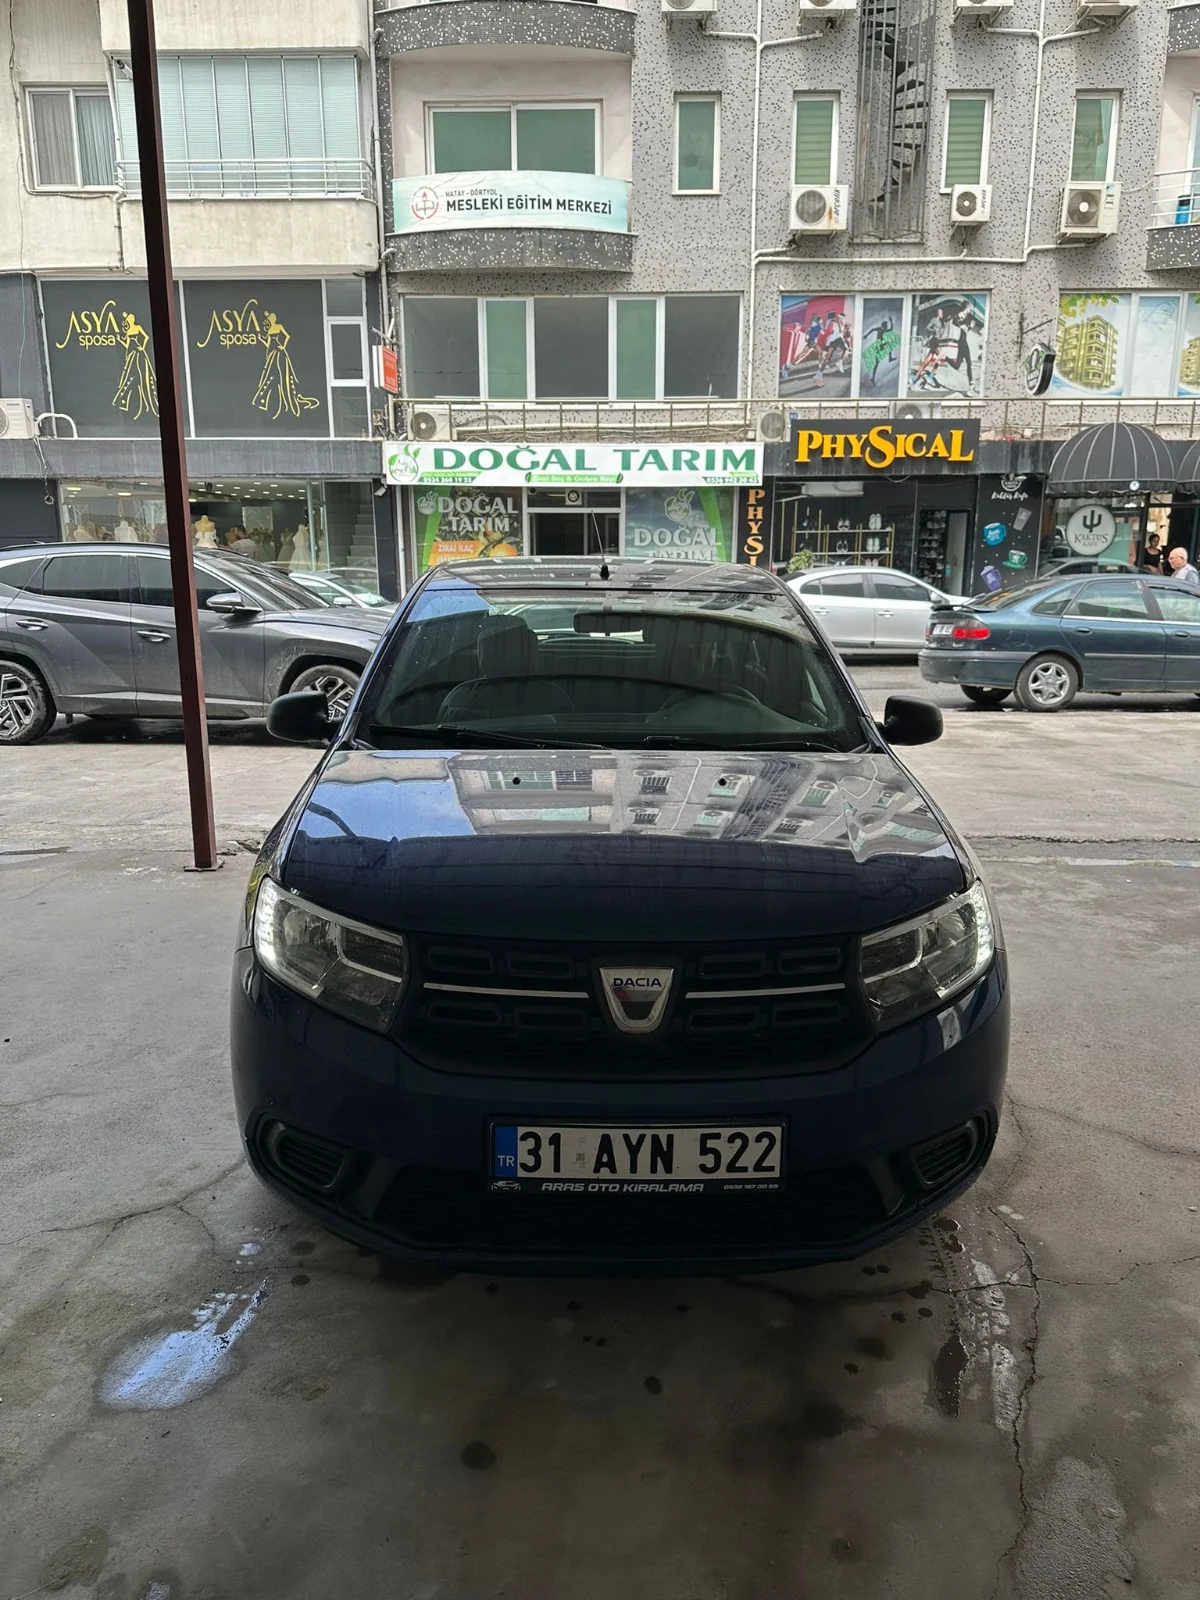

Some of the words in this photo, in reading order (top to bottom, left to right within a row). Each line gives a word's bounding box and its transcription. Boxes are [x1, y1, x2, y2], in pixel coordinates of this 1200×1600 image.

[470, 188, 498, 197] DÖRTYOL
[446, 194, 503, 212] MESLEKİ
[507, 194, 552, 210] EĞİTİM
[556, 198, 612, 215] MERKEZİ
[56, 300, 120, 349] ASYA
[196, 298, 261, 348] ASYA
[79, 333, 116, 350] sposa
[220, 332, 257, 349] sposa
[433, 445, 597, 471] DOĞAL
[613, 449, 756, 471] TARIM
[438, 493, 519, 514] DOĞAL
[450, 516, 510, 532] TARIM
[633, 525, 722, 546] DOĞAL
[613, 978, 662, 987] DACIA
[497, 1155, 515, 1167] TR
[519, 1131, 561, 1174] 31
[593, 1133, 674, 1175] AYN
[698, 1132, 777, 1174] 522
[541, 1183, 584, 1191] ARAS
[588, 1183, 620, 1192] OTO
